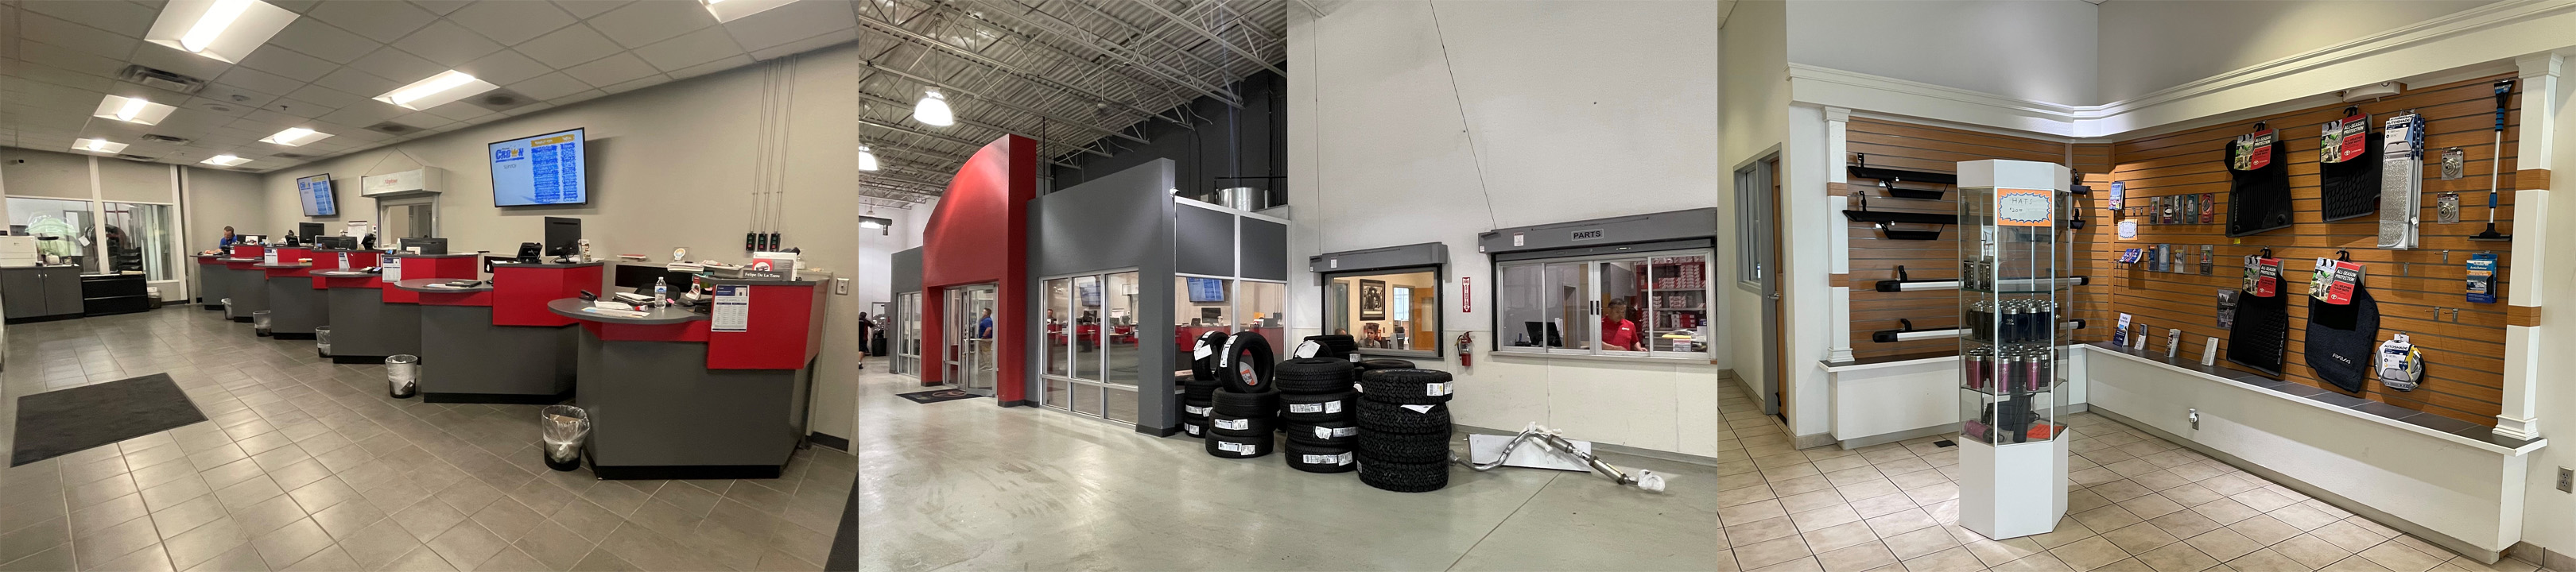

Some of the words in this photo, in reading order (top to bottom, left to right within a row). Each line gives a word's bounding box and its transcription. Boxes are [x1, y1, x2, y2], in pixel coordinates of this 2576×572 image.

[2344, 121, 2365, 130] ALL-SEASON
[2343, 126, 2364, 135] PROTECTION
[1573, 230, 1601, 239] PARTS
[2337, 269, 2357, 278] ALL-SEASON
